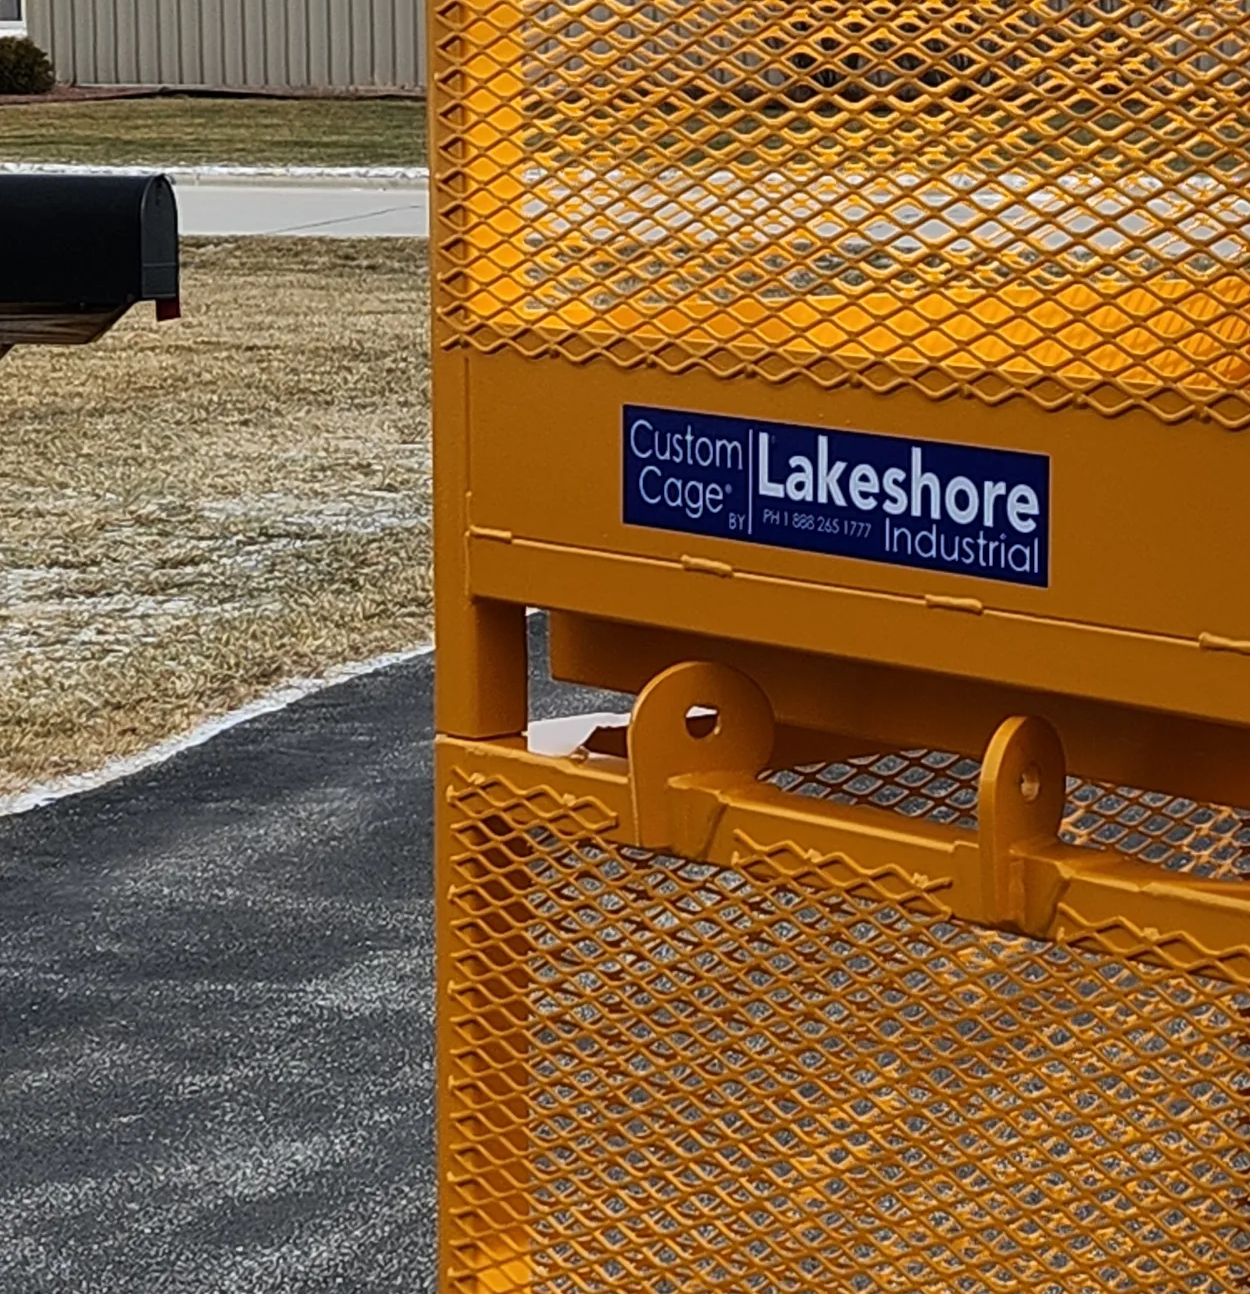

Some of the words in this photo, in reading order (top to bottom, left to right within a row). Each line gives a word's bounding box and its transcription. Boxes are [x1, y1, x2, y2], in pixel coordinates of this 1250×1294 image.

[630, 419, 743, 470] Custom
[758, 431, 1040, 534] Lakeshore
[728, 512, 745, 531] BY
[763, 508, 780, 525] PH
[783, 511, 788, 526] 1
[792, 512, 815, 530] 888
[817, 515, 840, 534] 265
[843, 520, 872, 538] 1777
[885, 517, 1040, 574] Industrial
